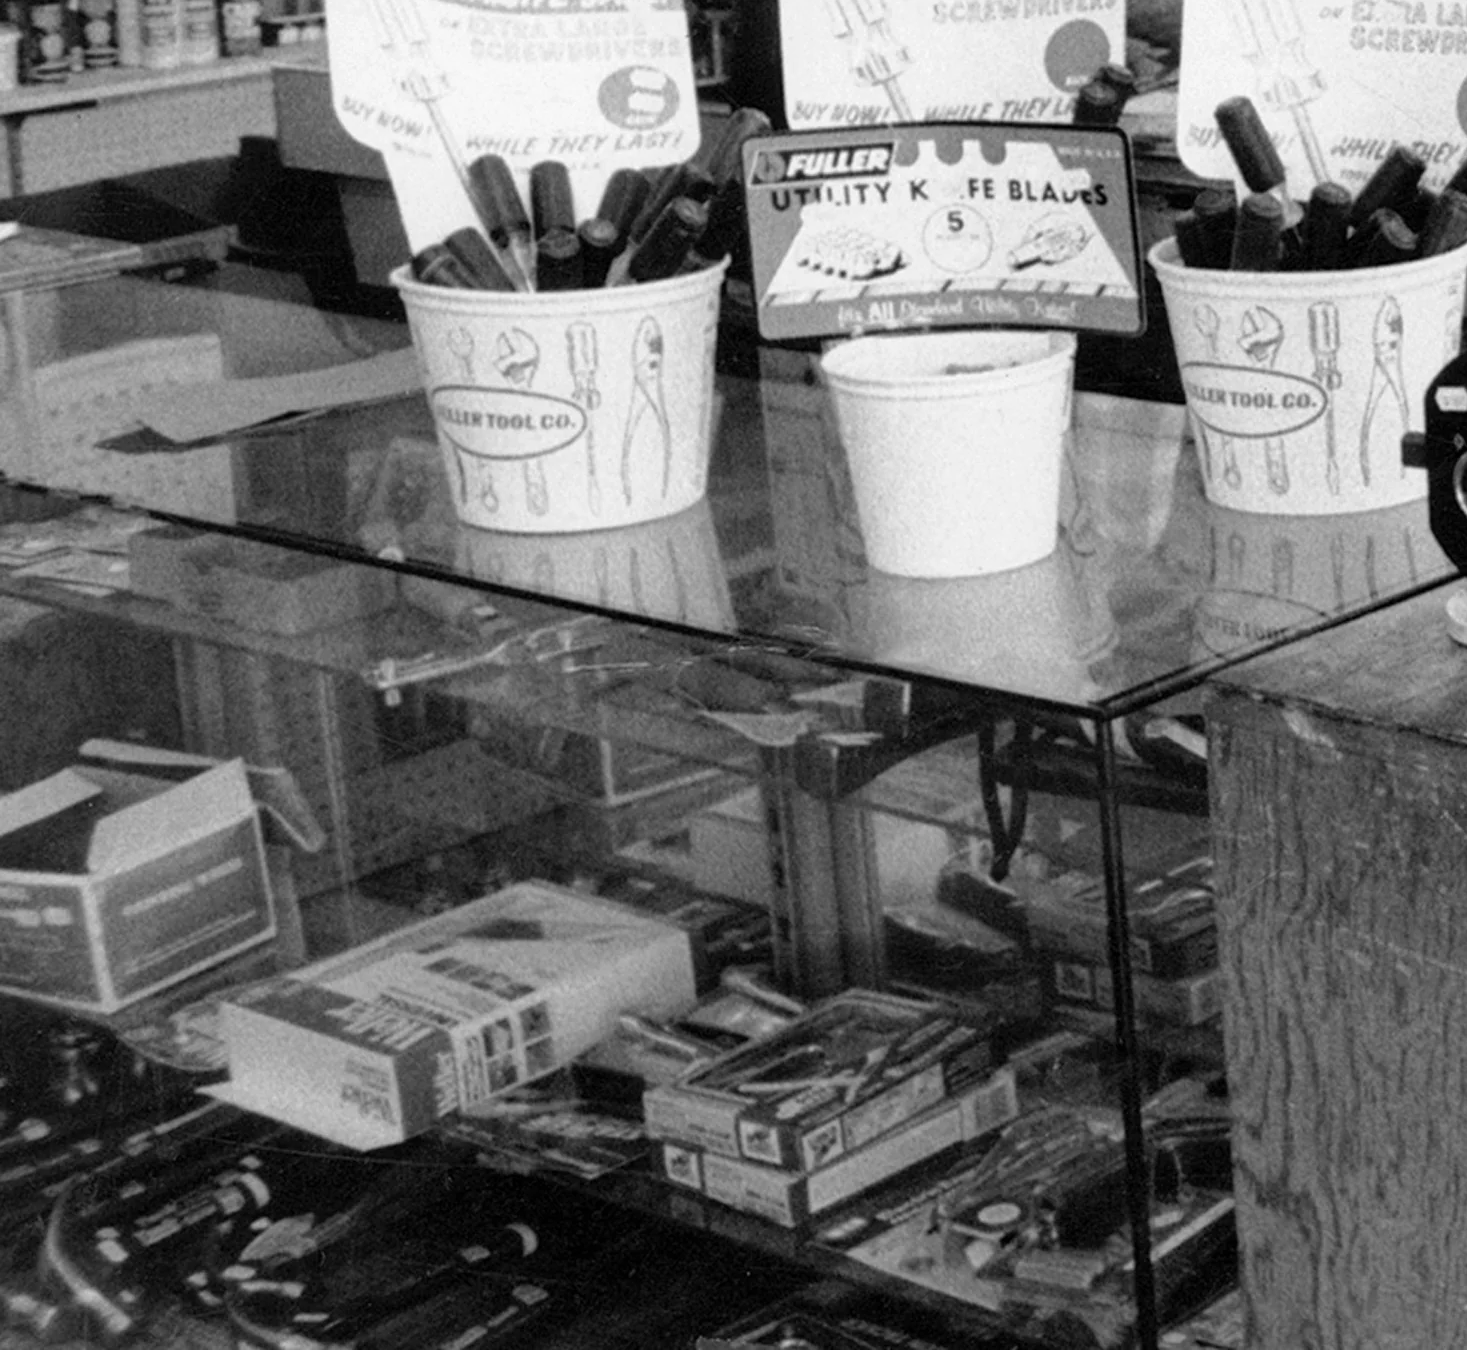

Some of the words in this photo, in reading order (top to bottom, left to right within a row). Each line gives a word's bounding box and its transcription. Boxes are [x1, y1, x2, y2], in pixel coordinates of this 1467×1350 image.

[342, 95, 377, 125] BUY
[378, 111, 434, 138] NOW!
[791, 101, 829, 124] BUY
[830, 103, 892, 125] NOW!
[924, 102, 994, 123] WHILE
[1001, 97, 1052, 121] THEY
[466, 134, 538, 155] WHILE
[549, 133, 607, 155] THEY
[614, 130, 685, 150] LAST!
[785, 148, 891, 178] FULLER
[909, 179, 996, 202] KFE
[946, 210, 965, 233] 5
[867, 300, 895, 322] All
[1229, 391, 1279, 409] TOOL
[1281, 391, 1318, 409] CO.
[485, 412, 537, 430] TOOL
[539, 413, 576, 430] CO.
